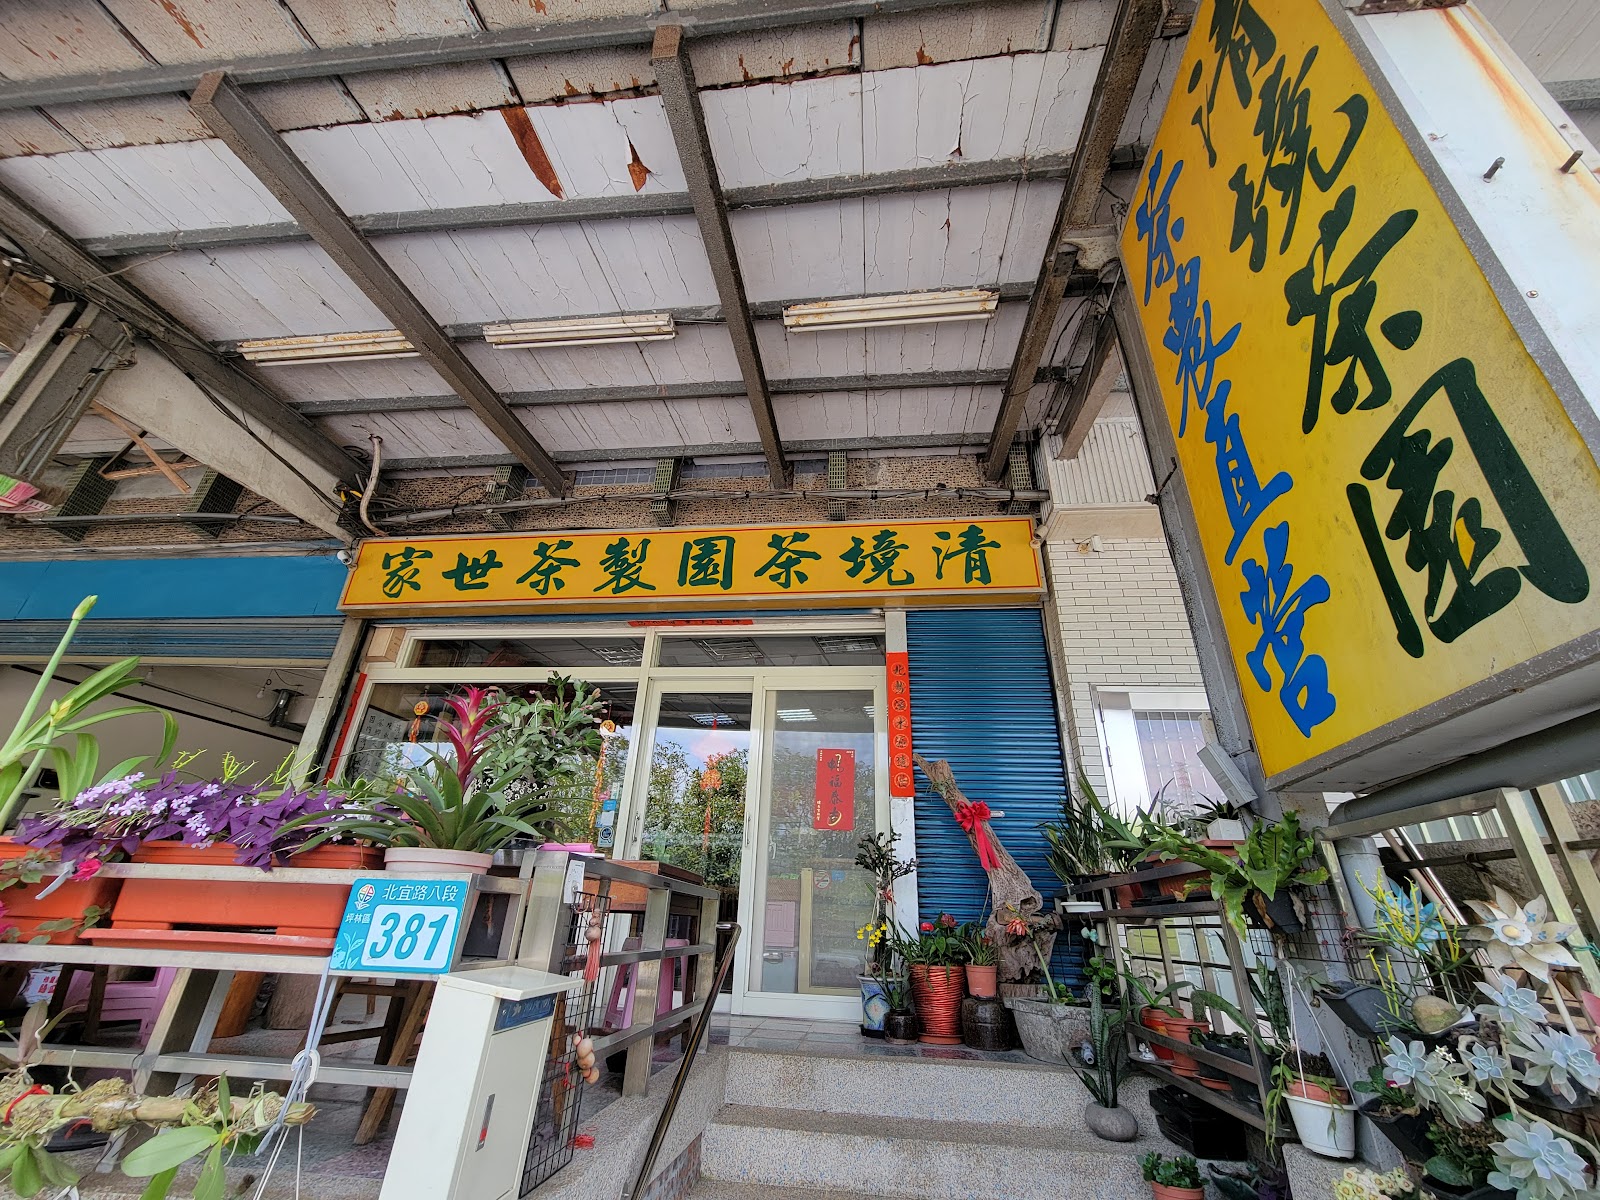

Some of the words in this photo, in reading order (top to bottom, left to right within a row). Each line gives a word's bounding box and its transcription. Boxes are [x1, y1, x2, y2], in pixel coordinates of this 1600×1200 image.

[381, 524, 1002, 598] 清境茶園製茶世家
[382, 883, 459, 902] 北宜路八段
[344, 912, 372, 924] 坪林區
[369, 912, 450, 960] 381
